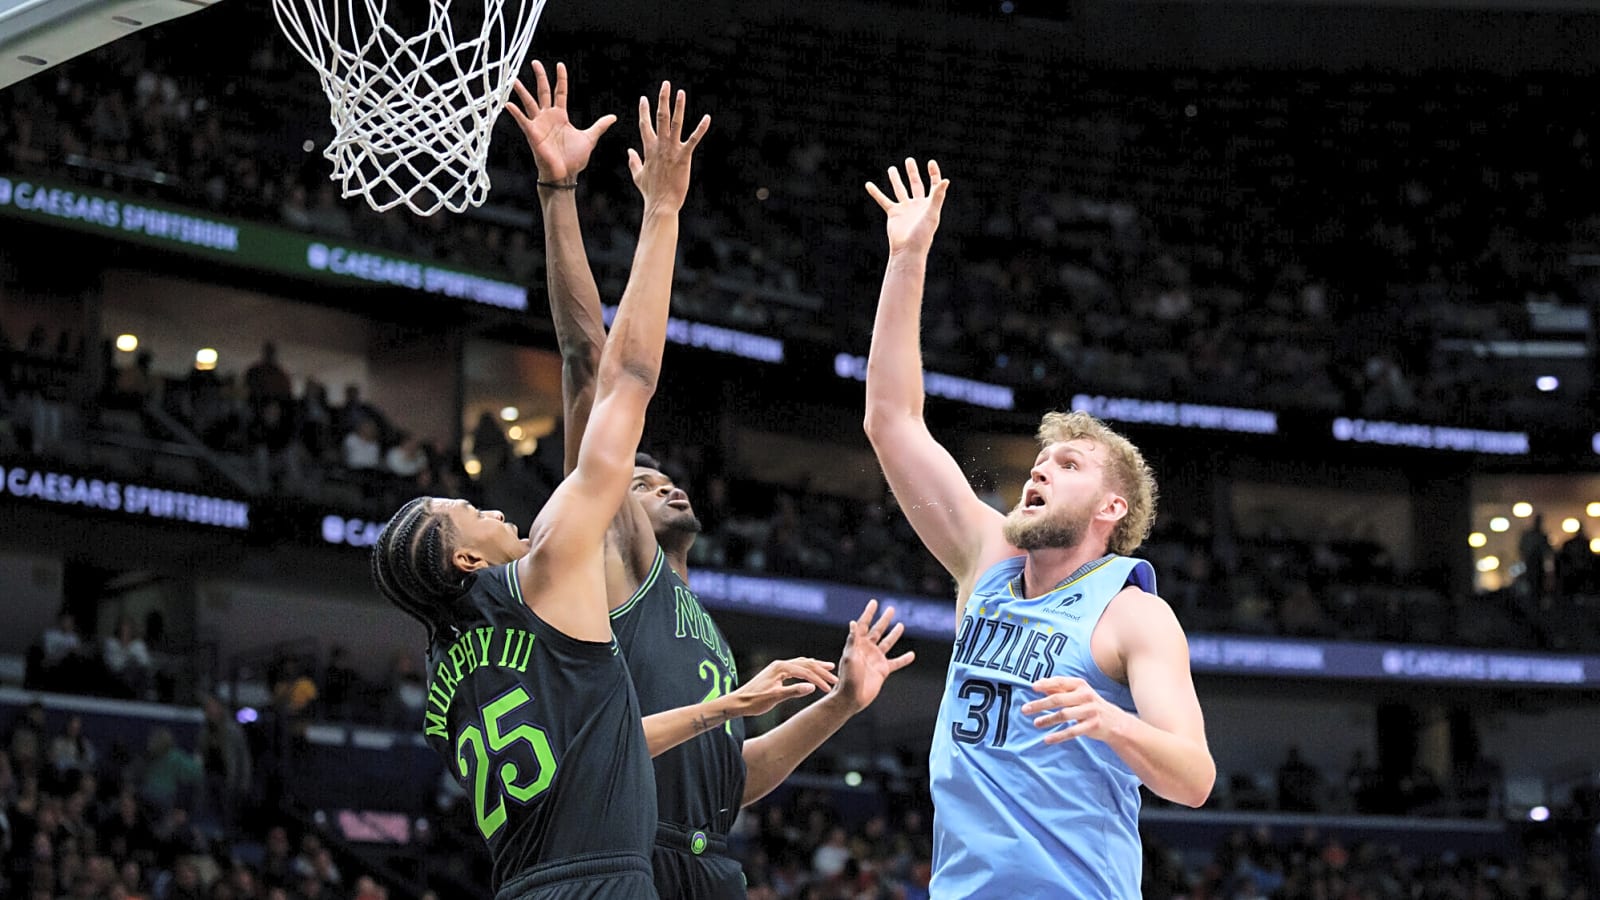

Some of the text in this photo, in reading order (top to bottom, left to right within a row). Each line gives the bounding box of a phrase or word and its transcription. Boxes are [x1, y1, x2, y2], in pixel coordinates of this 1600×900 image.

[14, 182, 239, 252] CAESARS SPORTSBOOK
[328, 246, 423, 291] CAESARS
[1351, 418, 1432, 447] CAESARS
[7, 466, 250, 531] CAESARS SPORTSBOOK
[953, 614, 1069, 683] RIZZLIES
[1042, 607, 1081, 622] Robinhood
[425, 626, 536, 741] MURPHY III
[951, 679, 1012, 747] 31
[455, 681, 560, 842] 25
